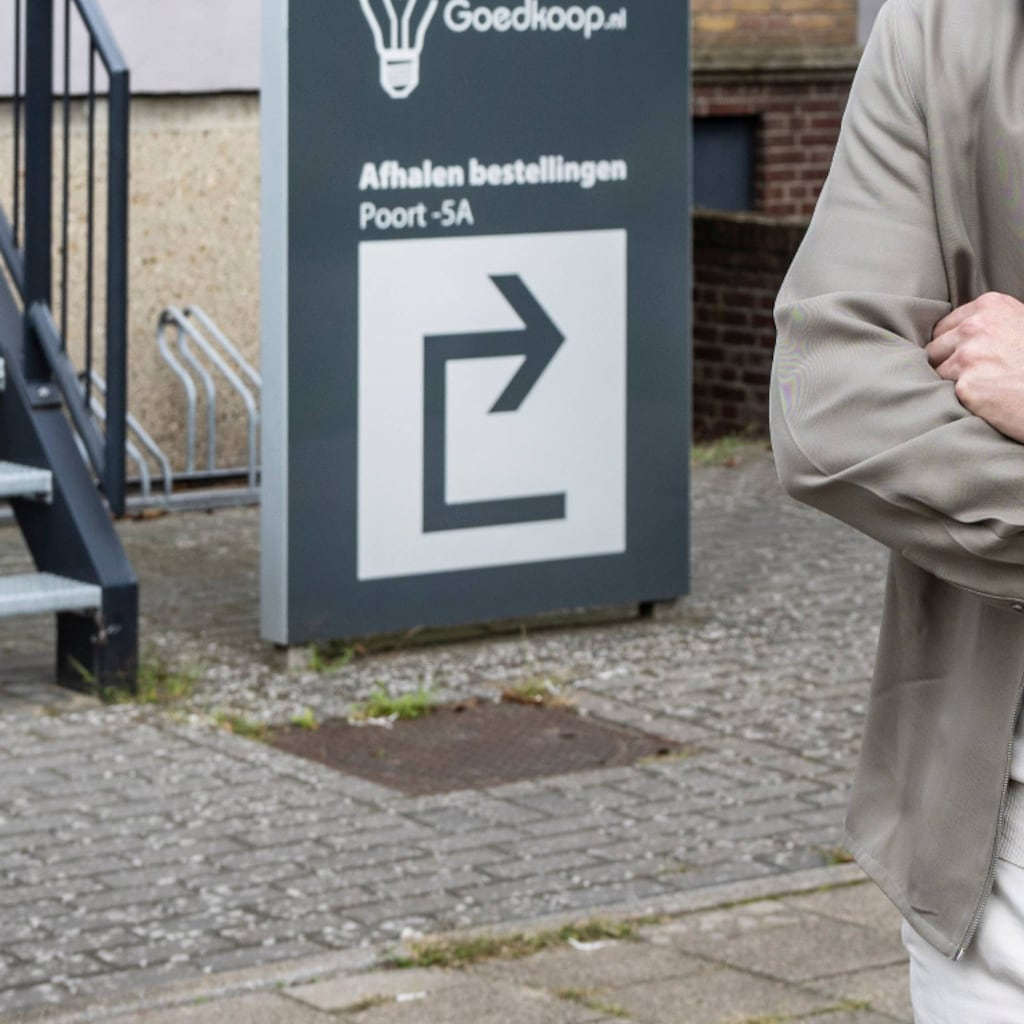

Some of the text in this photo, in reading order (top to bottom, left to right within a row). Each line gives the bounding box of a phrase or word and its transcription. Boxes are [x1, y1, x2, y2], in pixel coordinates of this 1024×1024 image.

[358, 154, 628, 191] Afhalen bestellingen
[359, 197, 475, 230] Poort -5A
